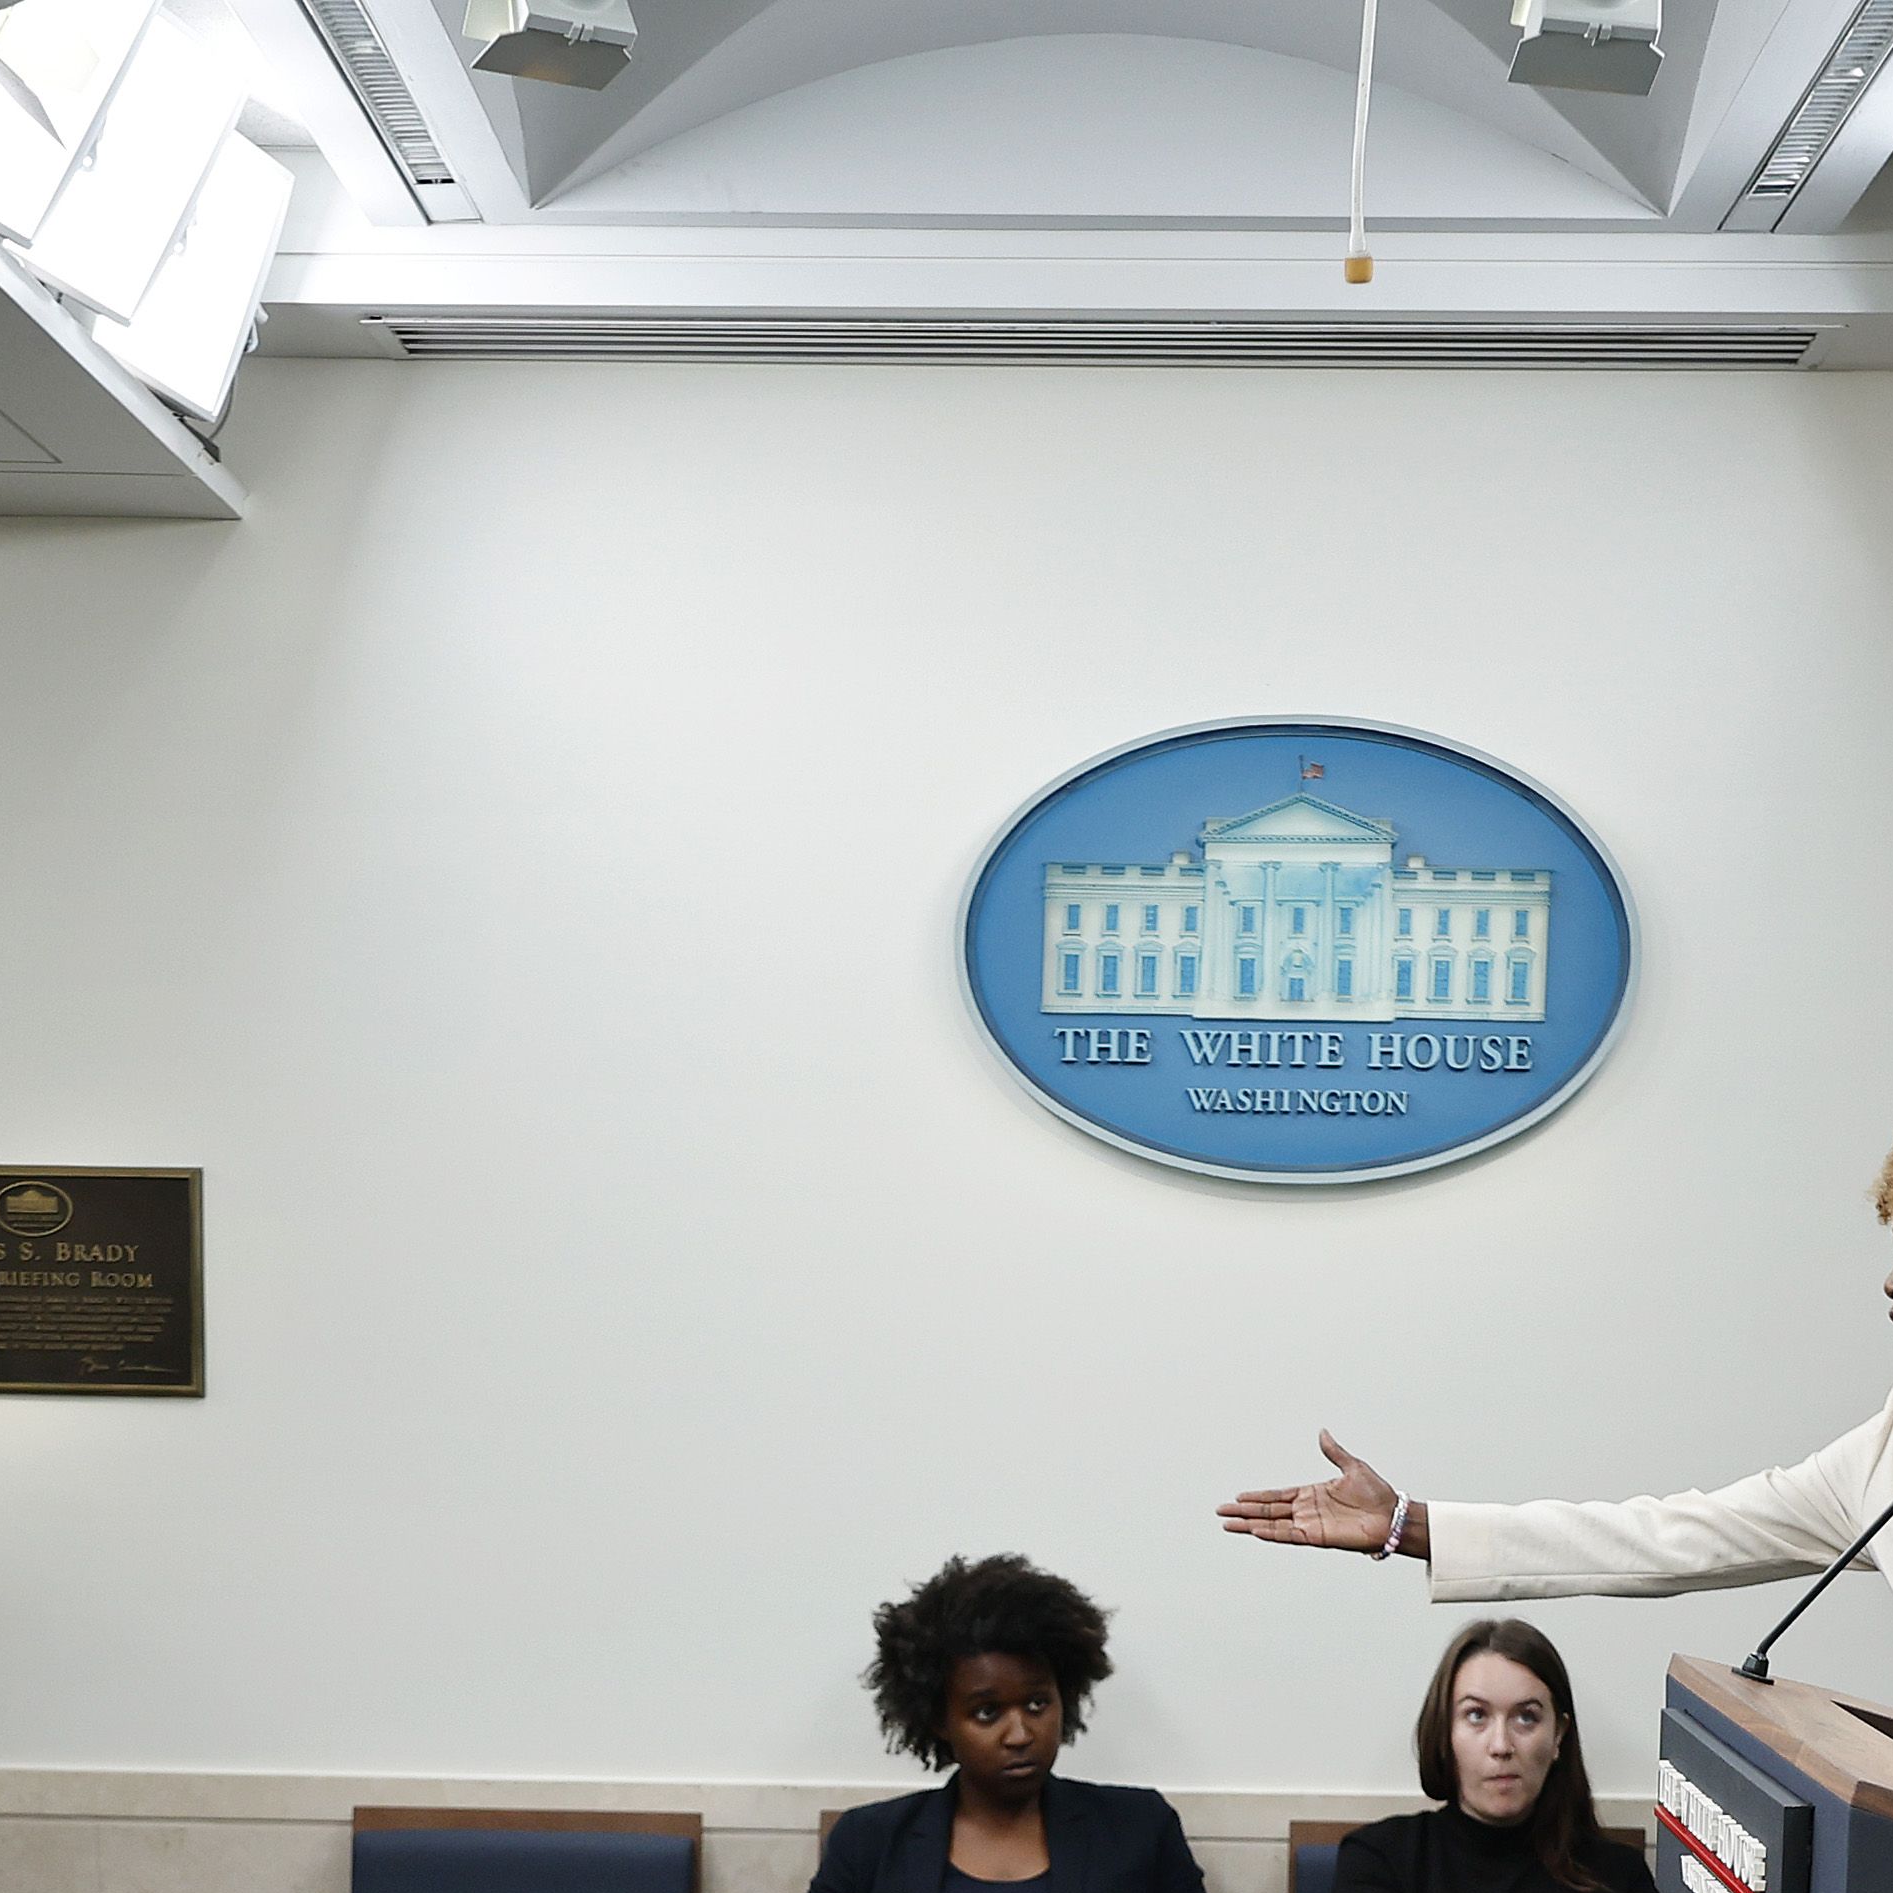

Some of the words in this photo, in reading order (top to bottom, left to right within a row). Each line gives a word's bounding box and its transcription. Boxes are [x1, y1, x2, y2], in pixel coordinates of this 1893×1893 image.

[1054, 1027, 1153, 1063] THE
[1180, 1029, 1345, 1067] WHITE
[1367, 1032, 1533, 1071] HOUSE
[1187, 1086, 1409, 1115] WASHINGTON
[18, 1241, 43, 1262] S.
[55, 1242, 140, 1263] BRADY
[90, 1270, 154, 1289] ROOM
